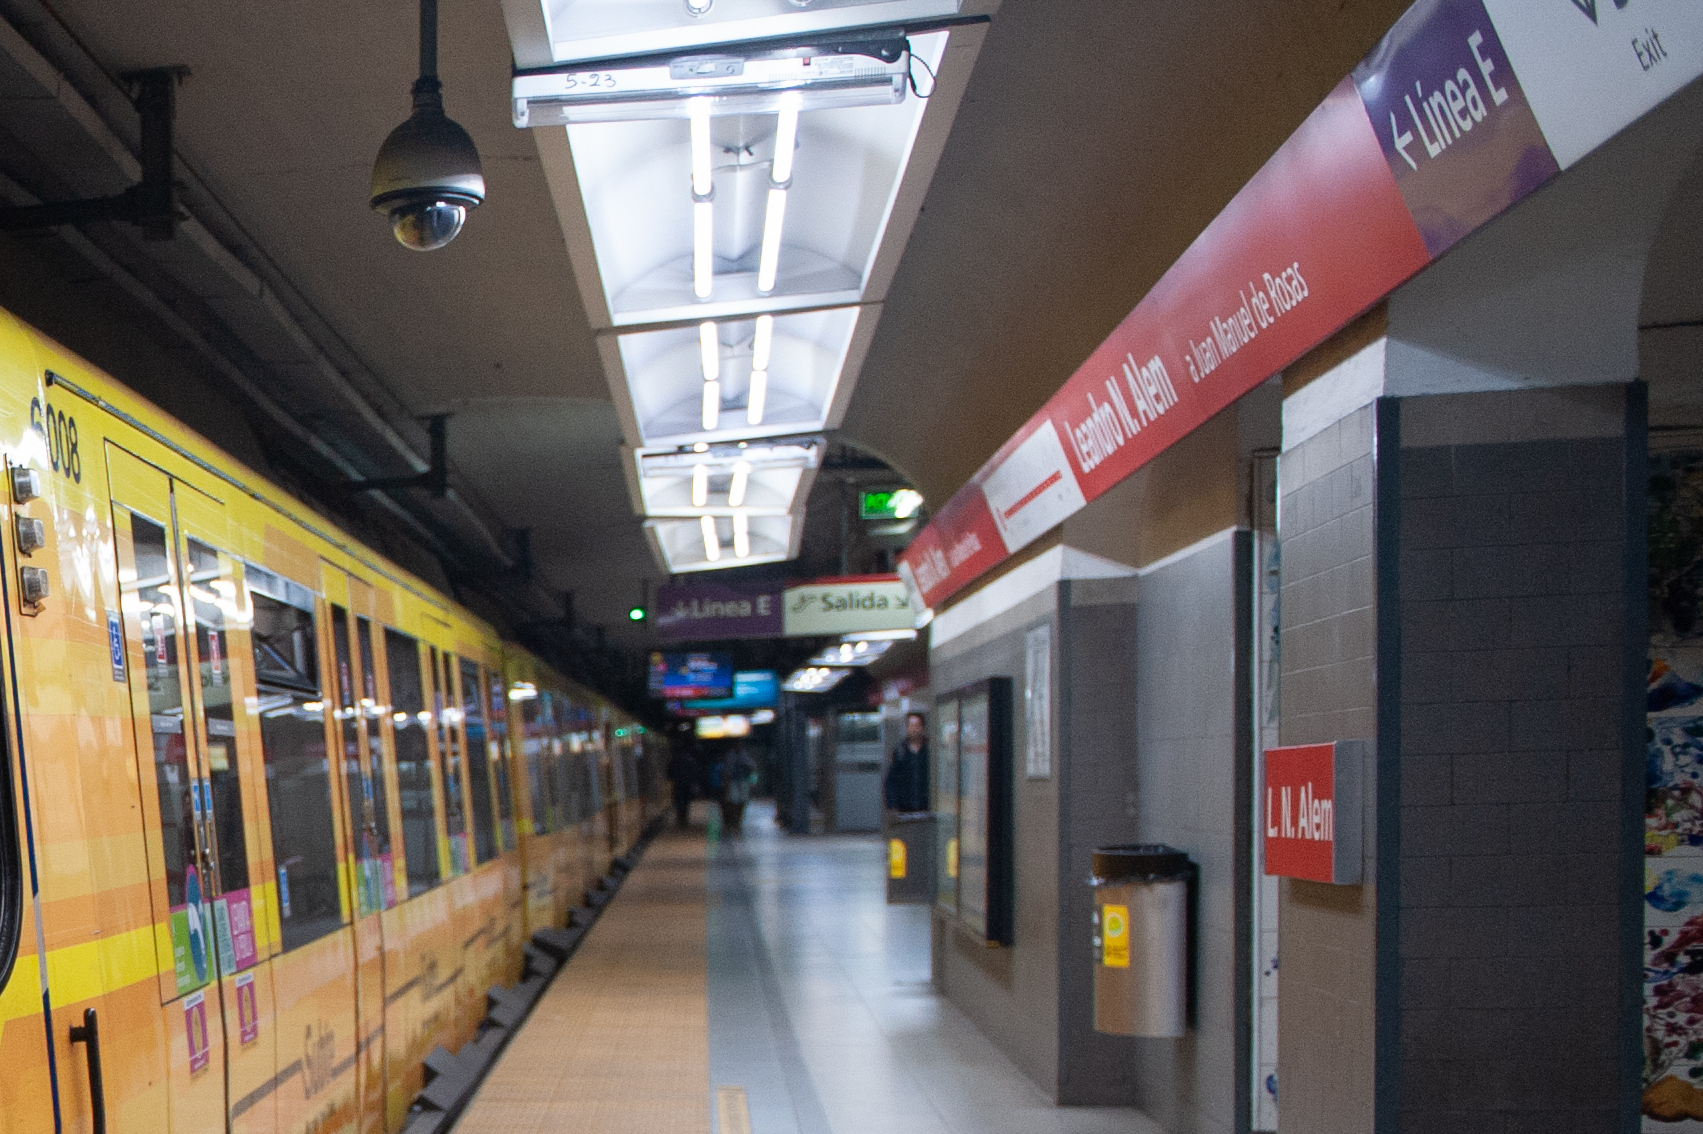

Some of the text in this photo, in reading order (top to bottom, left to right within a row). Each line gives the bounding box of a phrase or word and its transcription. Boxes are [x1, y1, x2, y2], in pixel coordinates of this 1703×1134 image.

[1404, 29, 1509, 159] Línea E
[1631, 27, 1667, 71] Exit
[1185, 261, 1310, 384] a Juan Manuel de Rosas
[1064, 353, 1179, 474] Leandro N. Alem
[820, 591, 890, 613] Salida
[1267, 781, 1334, 841] L. N. Alem
